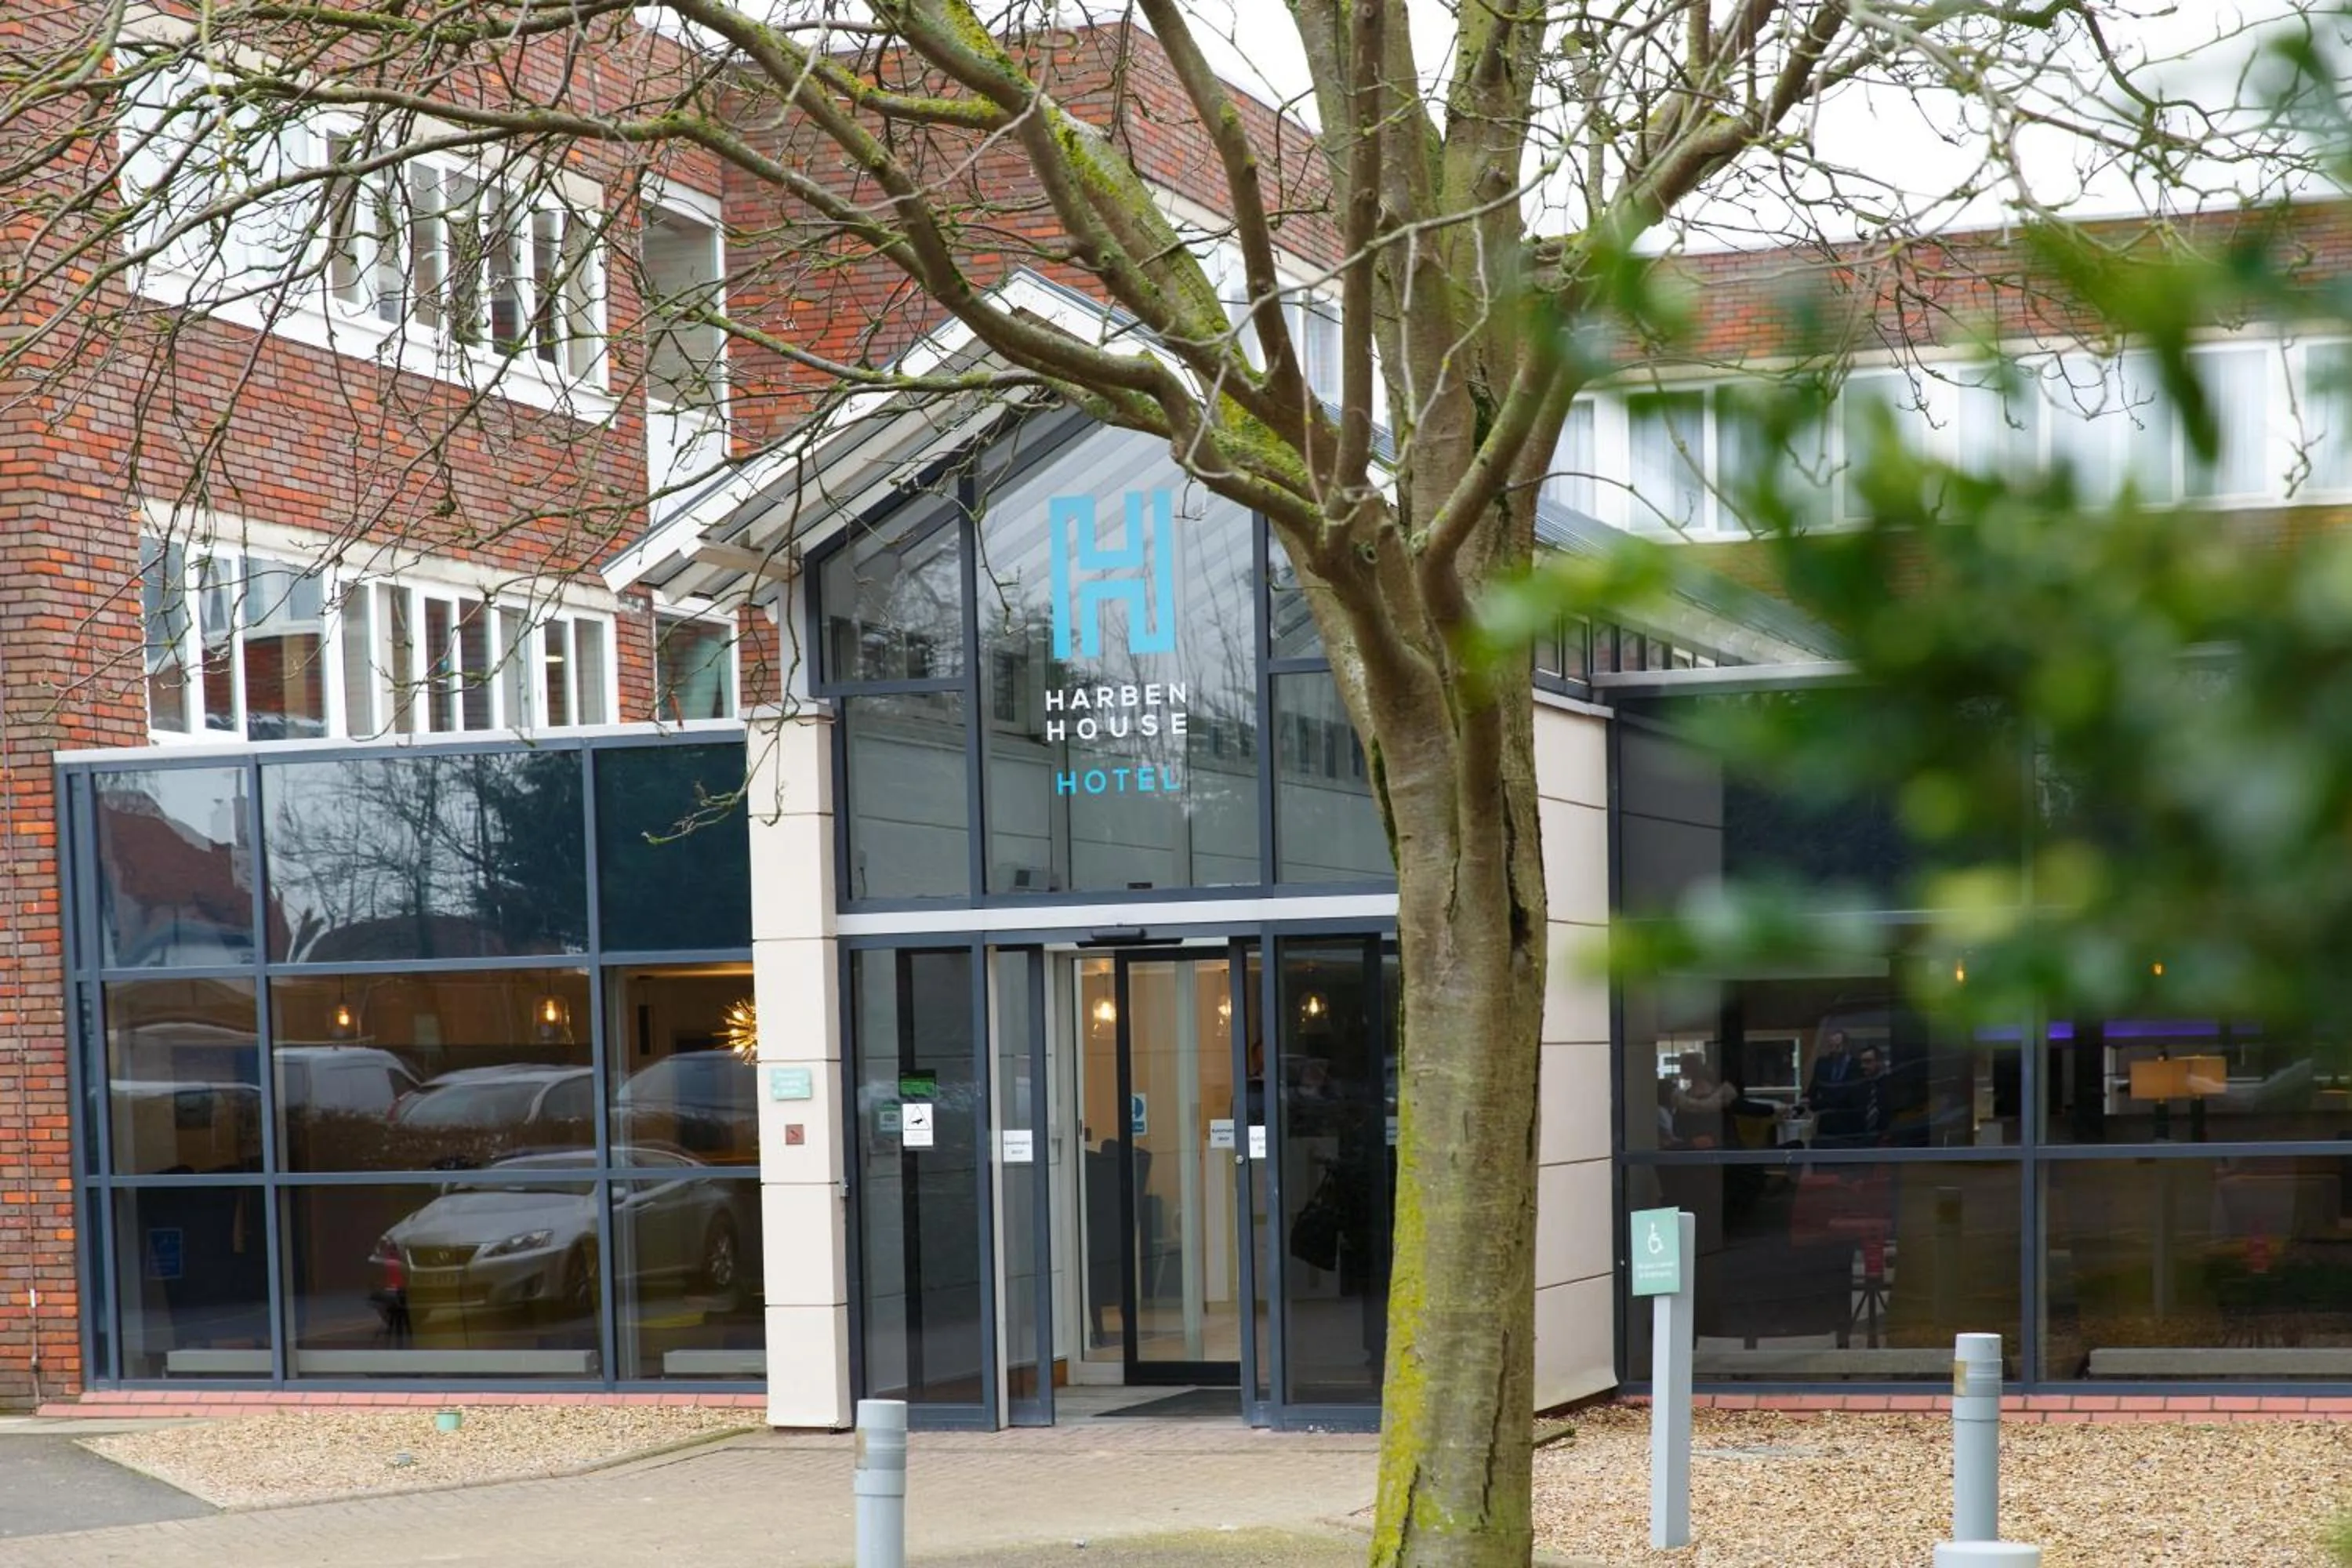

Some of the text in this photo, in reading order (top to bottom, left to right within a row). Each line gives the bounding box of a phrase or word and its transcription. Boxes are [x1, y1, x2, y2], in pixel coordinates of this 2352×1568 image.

[1045, 682, 1187, 711] HARBEN
[1047, 713, 1187, 741] HOUSE
[1056, 767, 1180, 795] HOTEL
